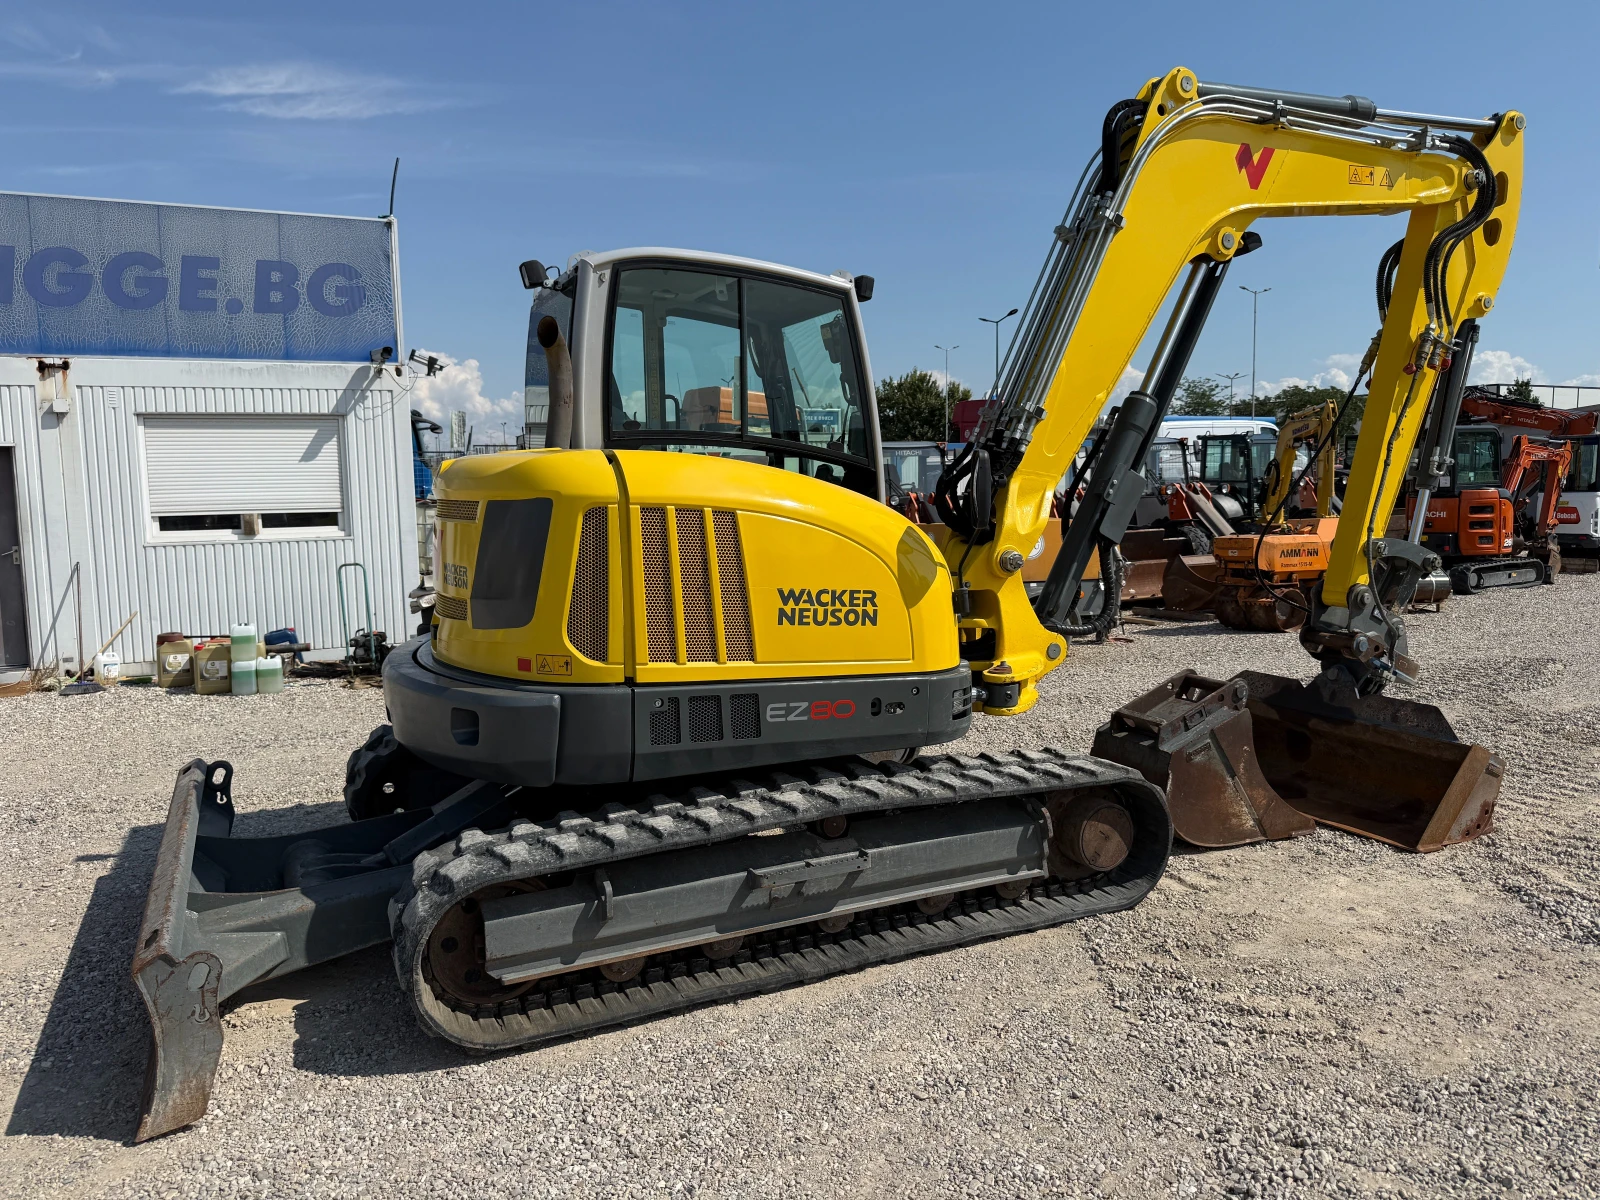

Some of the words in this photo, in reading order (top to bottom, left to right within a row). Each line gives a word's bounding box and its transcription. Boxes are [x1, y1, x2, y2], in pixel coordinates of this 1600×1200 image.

[1279, 548, 1319, 559] AMMANN
[443, 562, 468, 578] WACKER
[443, 573, 468, 590] NEUSON
[777, 587, 878, 608] WACKER
[777, 607, 878, 627] NEUSON
[766, 699, 856, 722] EZ80
